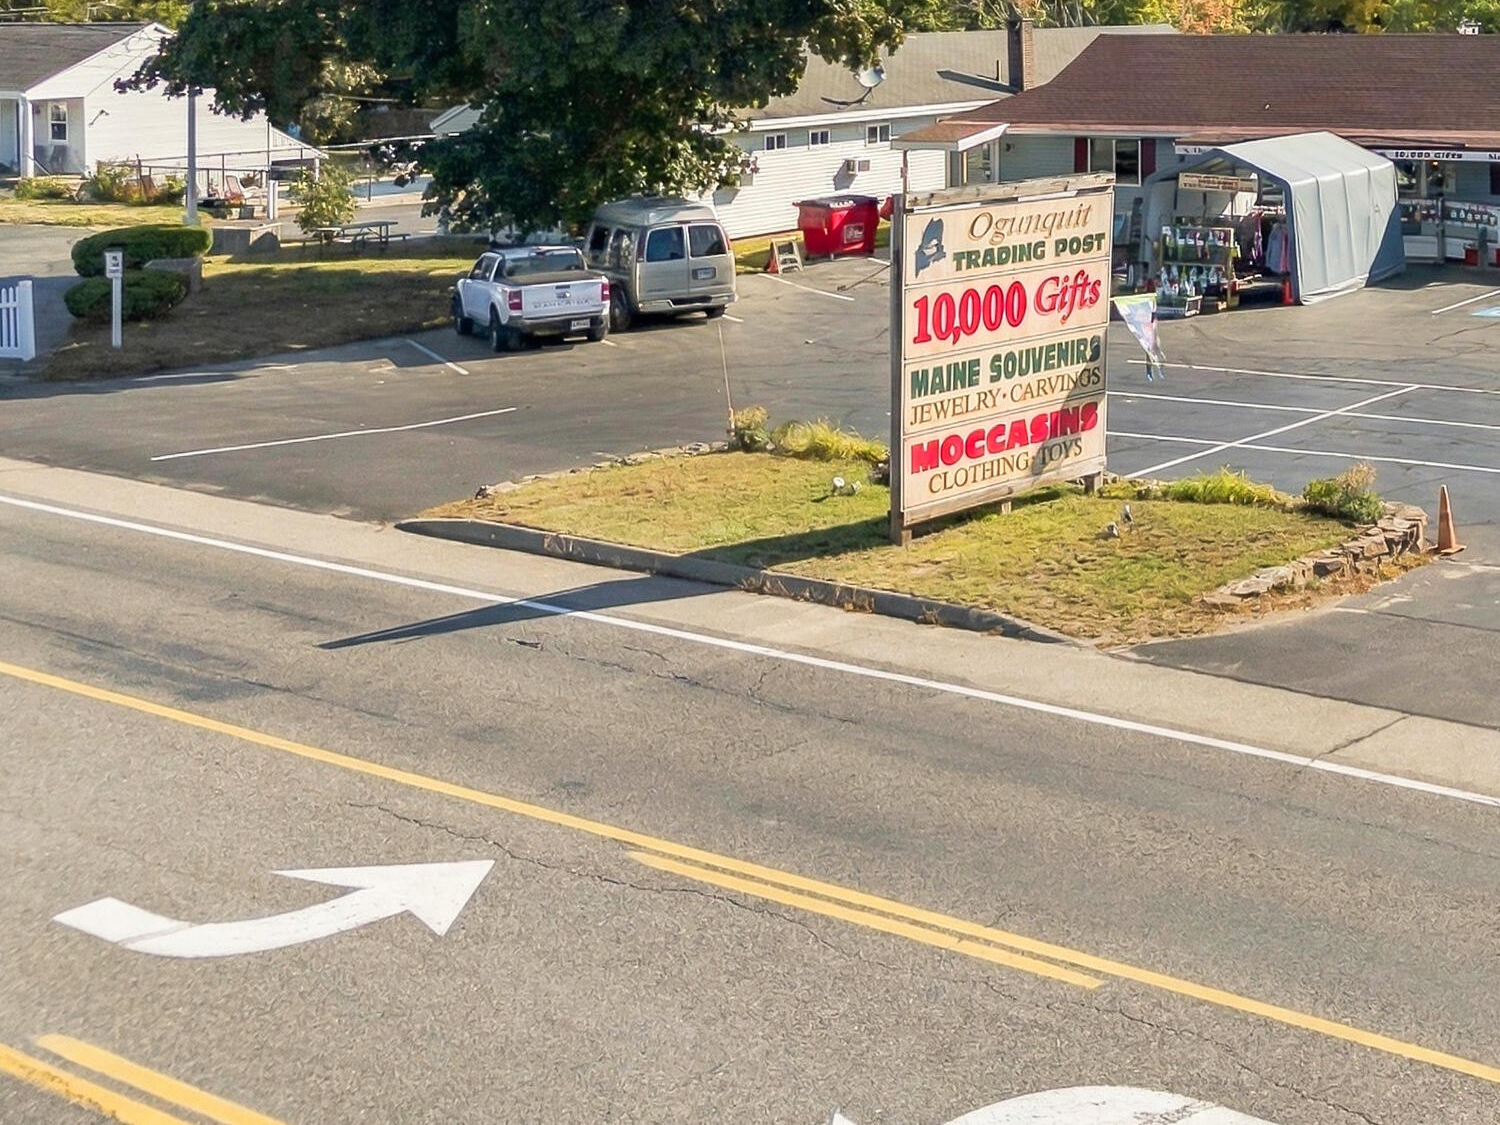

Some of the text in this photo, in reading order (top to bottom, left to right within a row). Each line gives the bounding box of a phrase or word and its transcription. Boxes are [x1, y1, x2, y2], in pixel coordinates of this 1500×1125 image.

[952, 232, 1107, 272] TRADING POST
[967, 203, 1092, 245] Ogunquit
[913, 269, 1102, 345] 10,000 Gifts
[910, 366, 1101, 426] JEWELRY CARVINGS
[911, 335, 1102, 400] MAINE SOUVENIRS
[911, 402, 1099, 475] MOCCASINS
[929, 437, 1083, 494] CLOTHING TOYS
